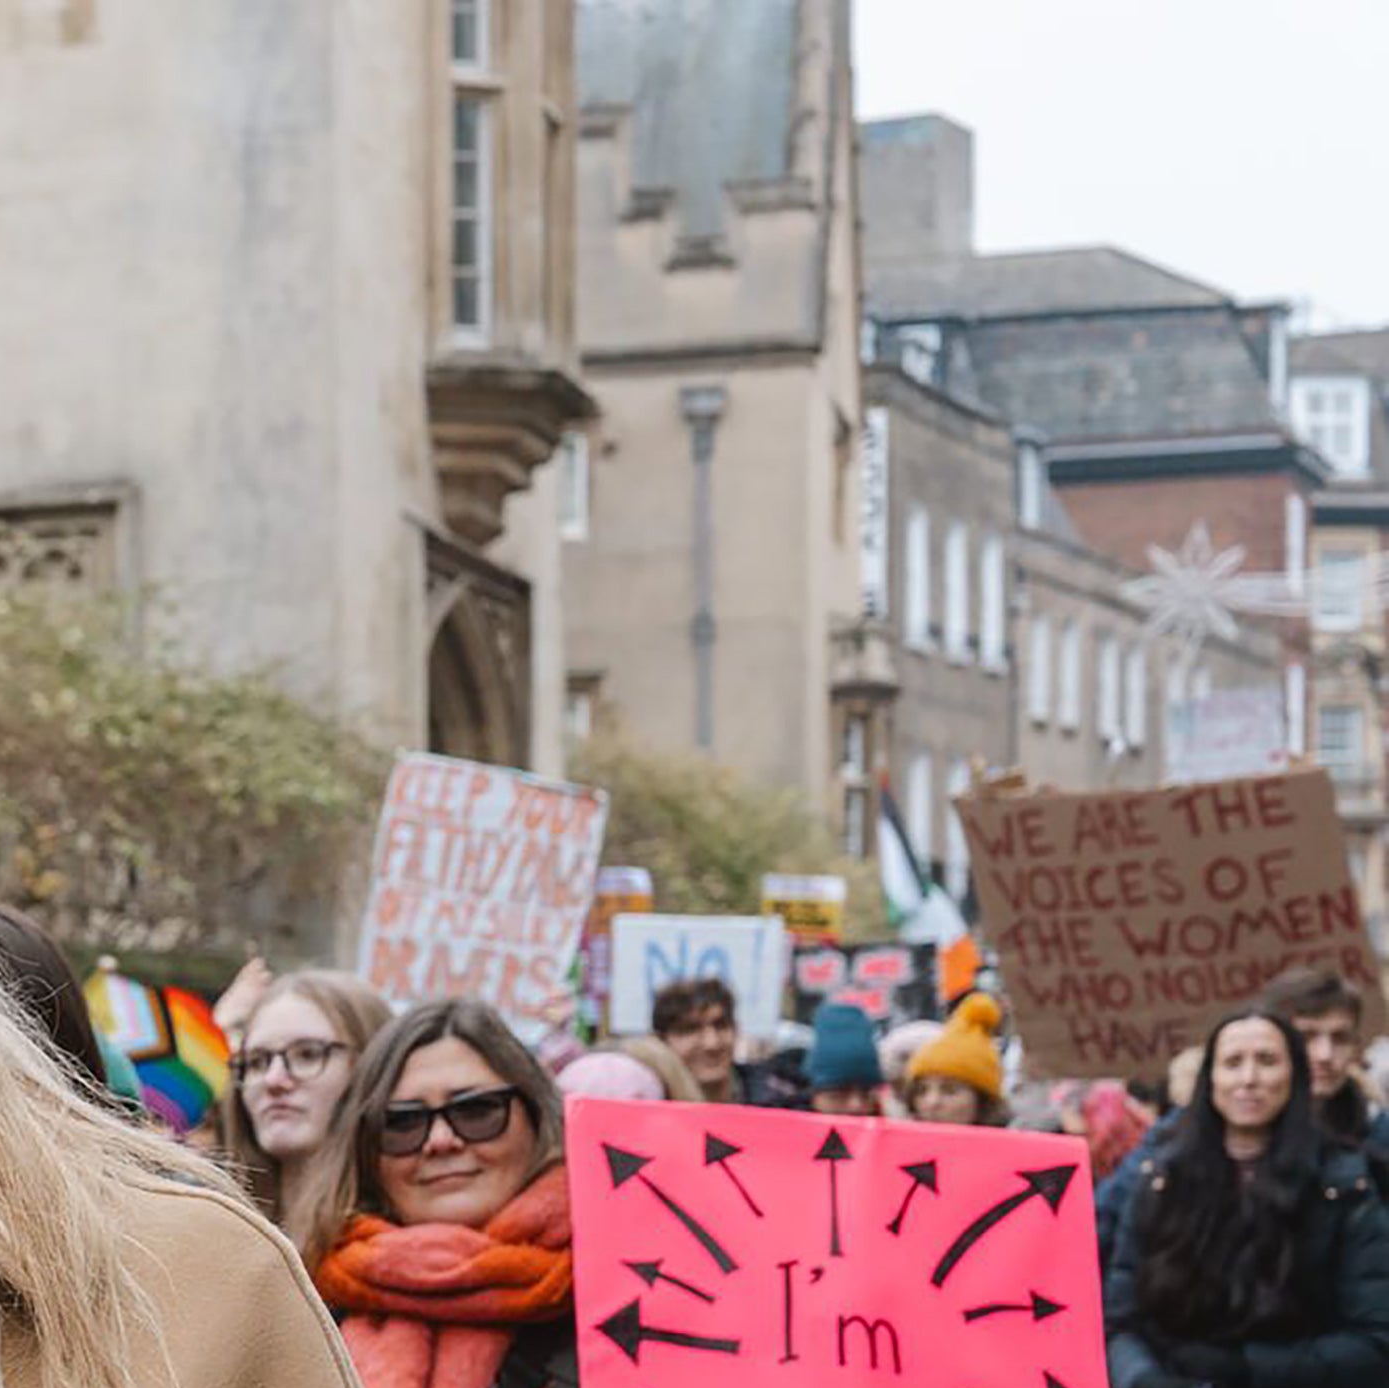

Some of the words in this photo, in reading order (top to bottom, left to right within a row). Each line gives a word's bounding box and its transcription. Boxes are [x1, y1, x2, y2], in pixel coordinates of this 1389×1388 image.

[967, 808, 1057, 860] WE
[1072, 797, 1159, 857] ARE
[1169, 777, 1294, 838] THE
[991, 857, 1185, 912] VOICES
[1205, 848, 1293, 900] OF
[996, 917, 1104, 968] THE
[1116, 887, 1362, 961] WOMEN
[1022, 968, 1134, 1016] WHO
[1067, 1016, 1193, 1062] HAVE
[776, 1259, 903, 1375] I'm
